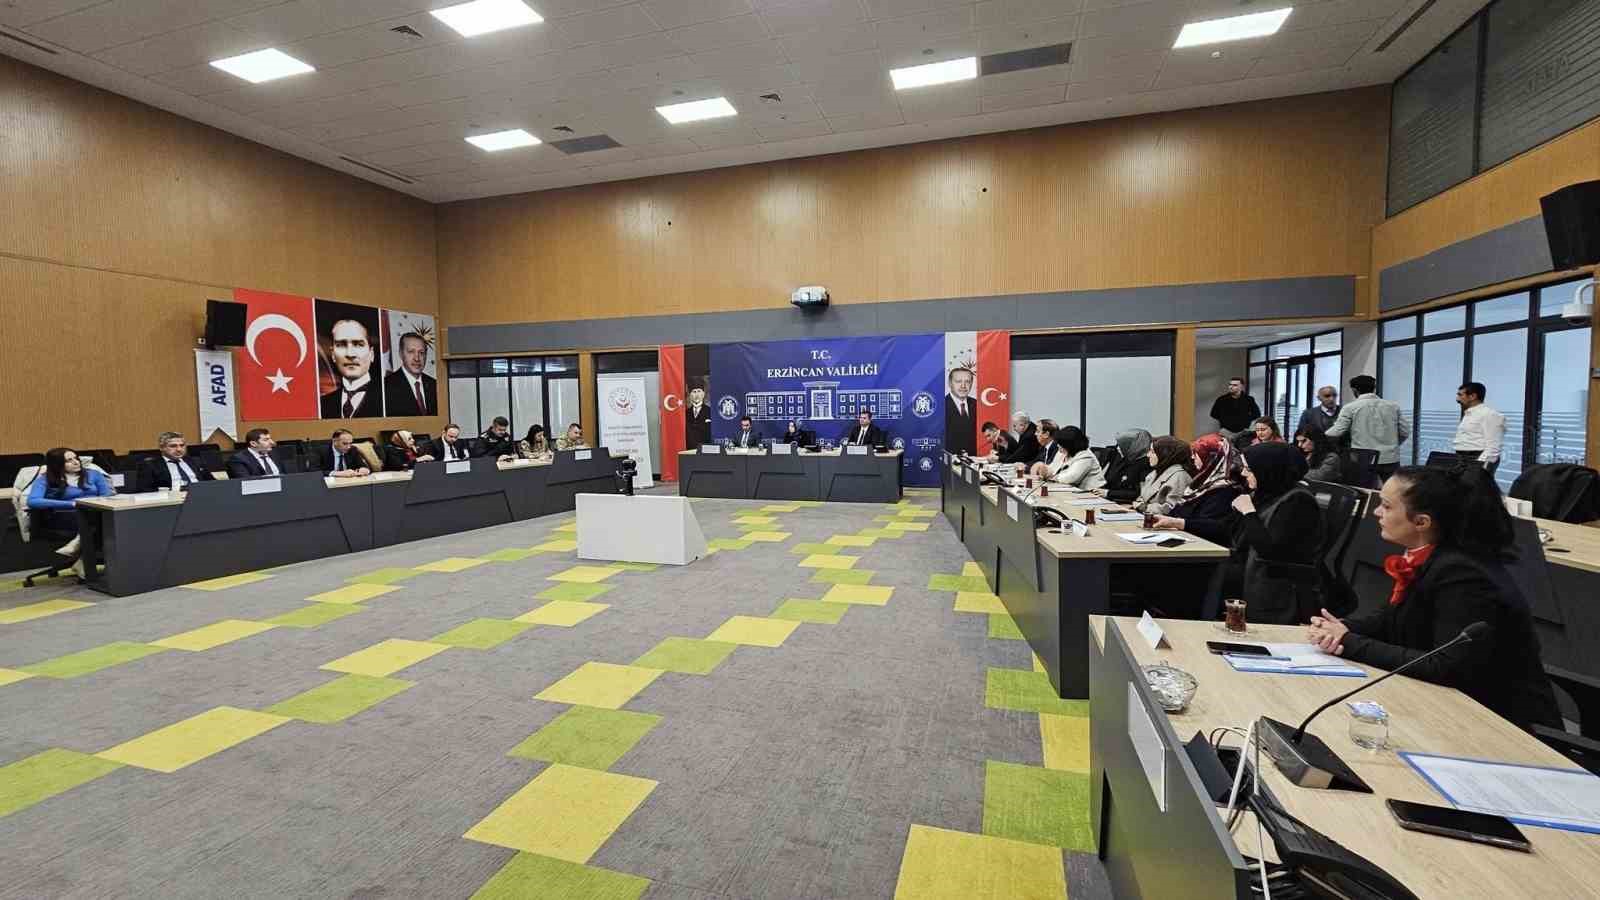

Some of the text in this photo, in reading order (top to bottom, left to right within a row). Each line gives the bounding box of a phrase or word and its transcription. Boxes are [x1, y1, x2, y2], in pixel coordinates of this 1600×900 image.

[810, 350, 832, 360] T.C.
[767, 363, 878, 378] ERZİNCAN VALİLİĞİ
[210, 364, 227, 406] AFAD
